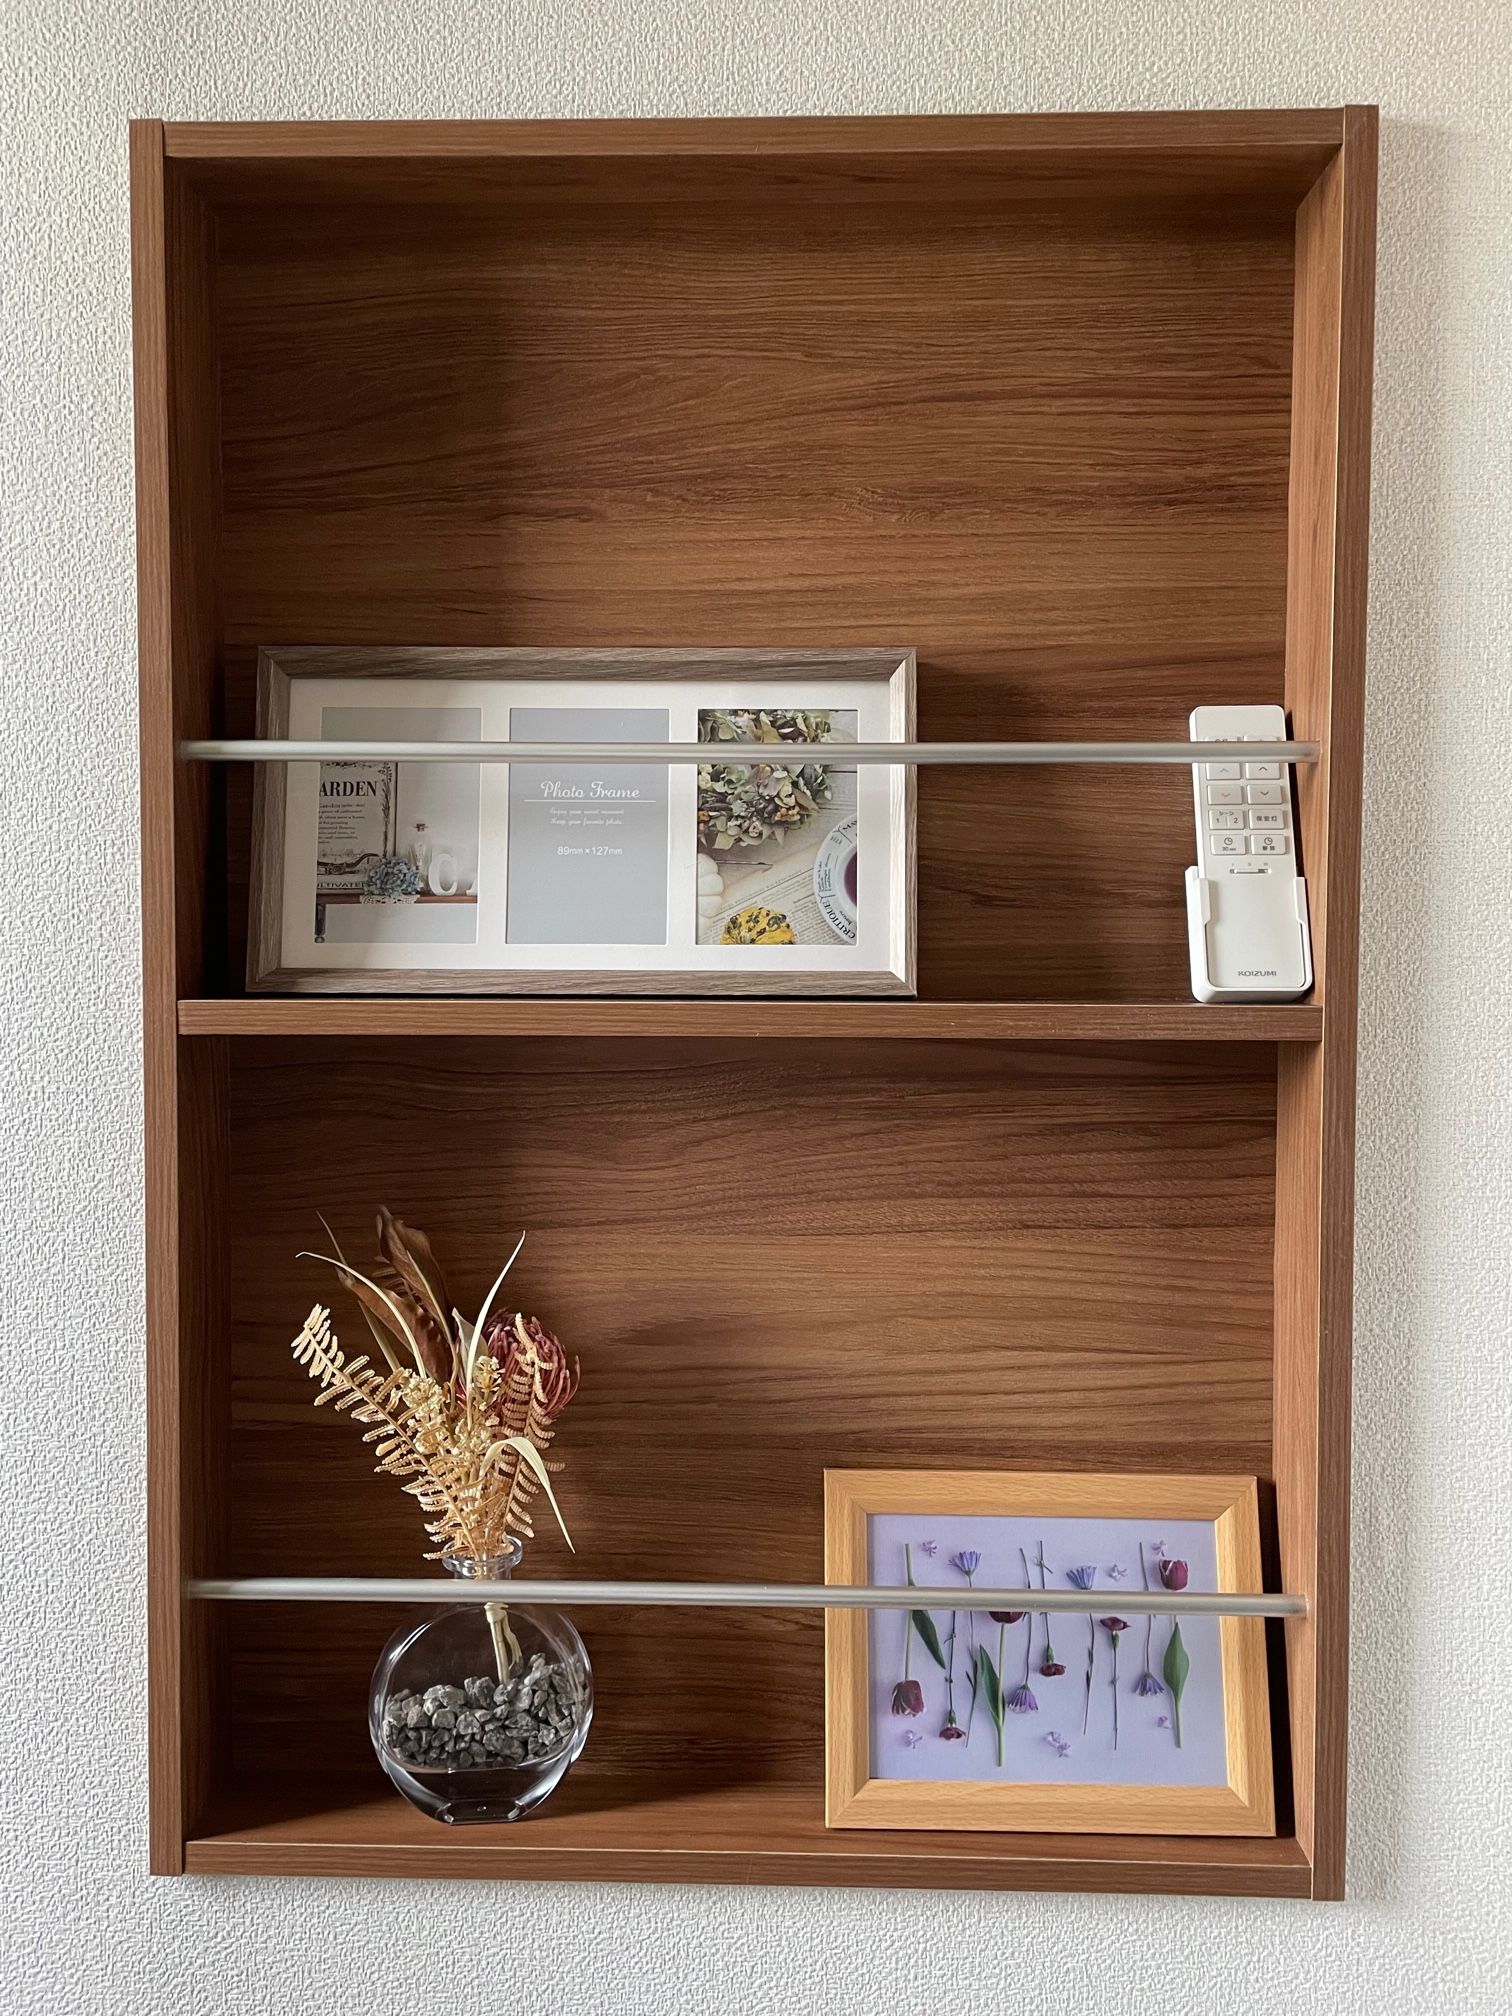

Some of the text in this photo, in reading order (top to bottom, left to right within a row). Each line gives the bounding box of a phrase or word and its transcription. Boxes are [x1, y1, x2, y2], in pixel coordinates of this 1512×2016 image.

[318, 780, 378, 797] ARDEN
[540, 780, 641, 798] Photo Frame
